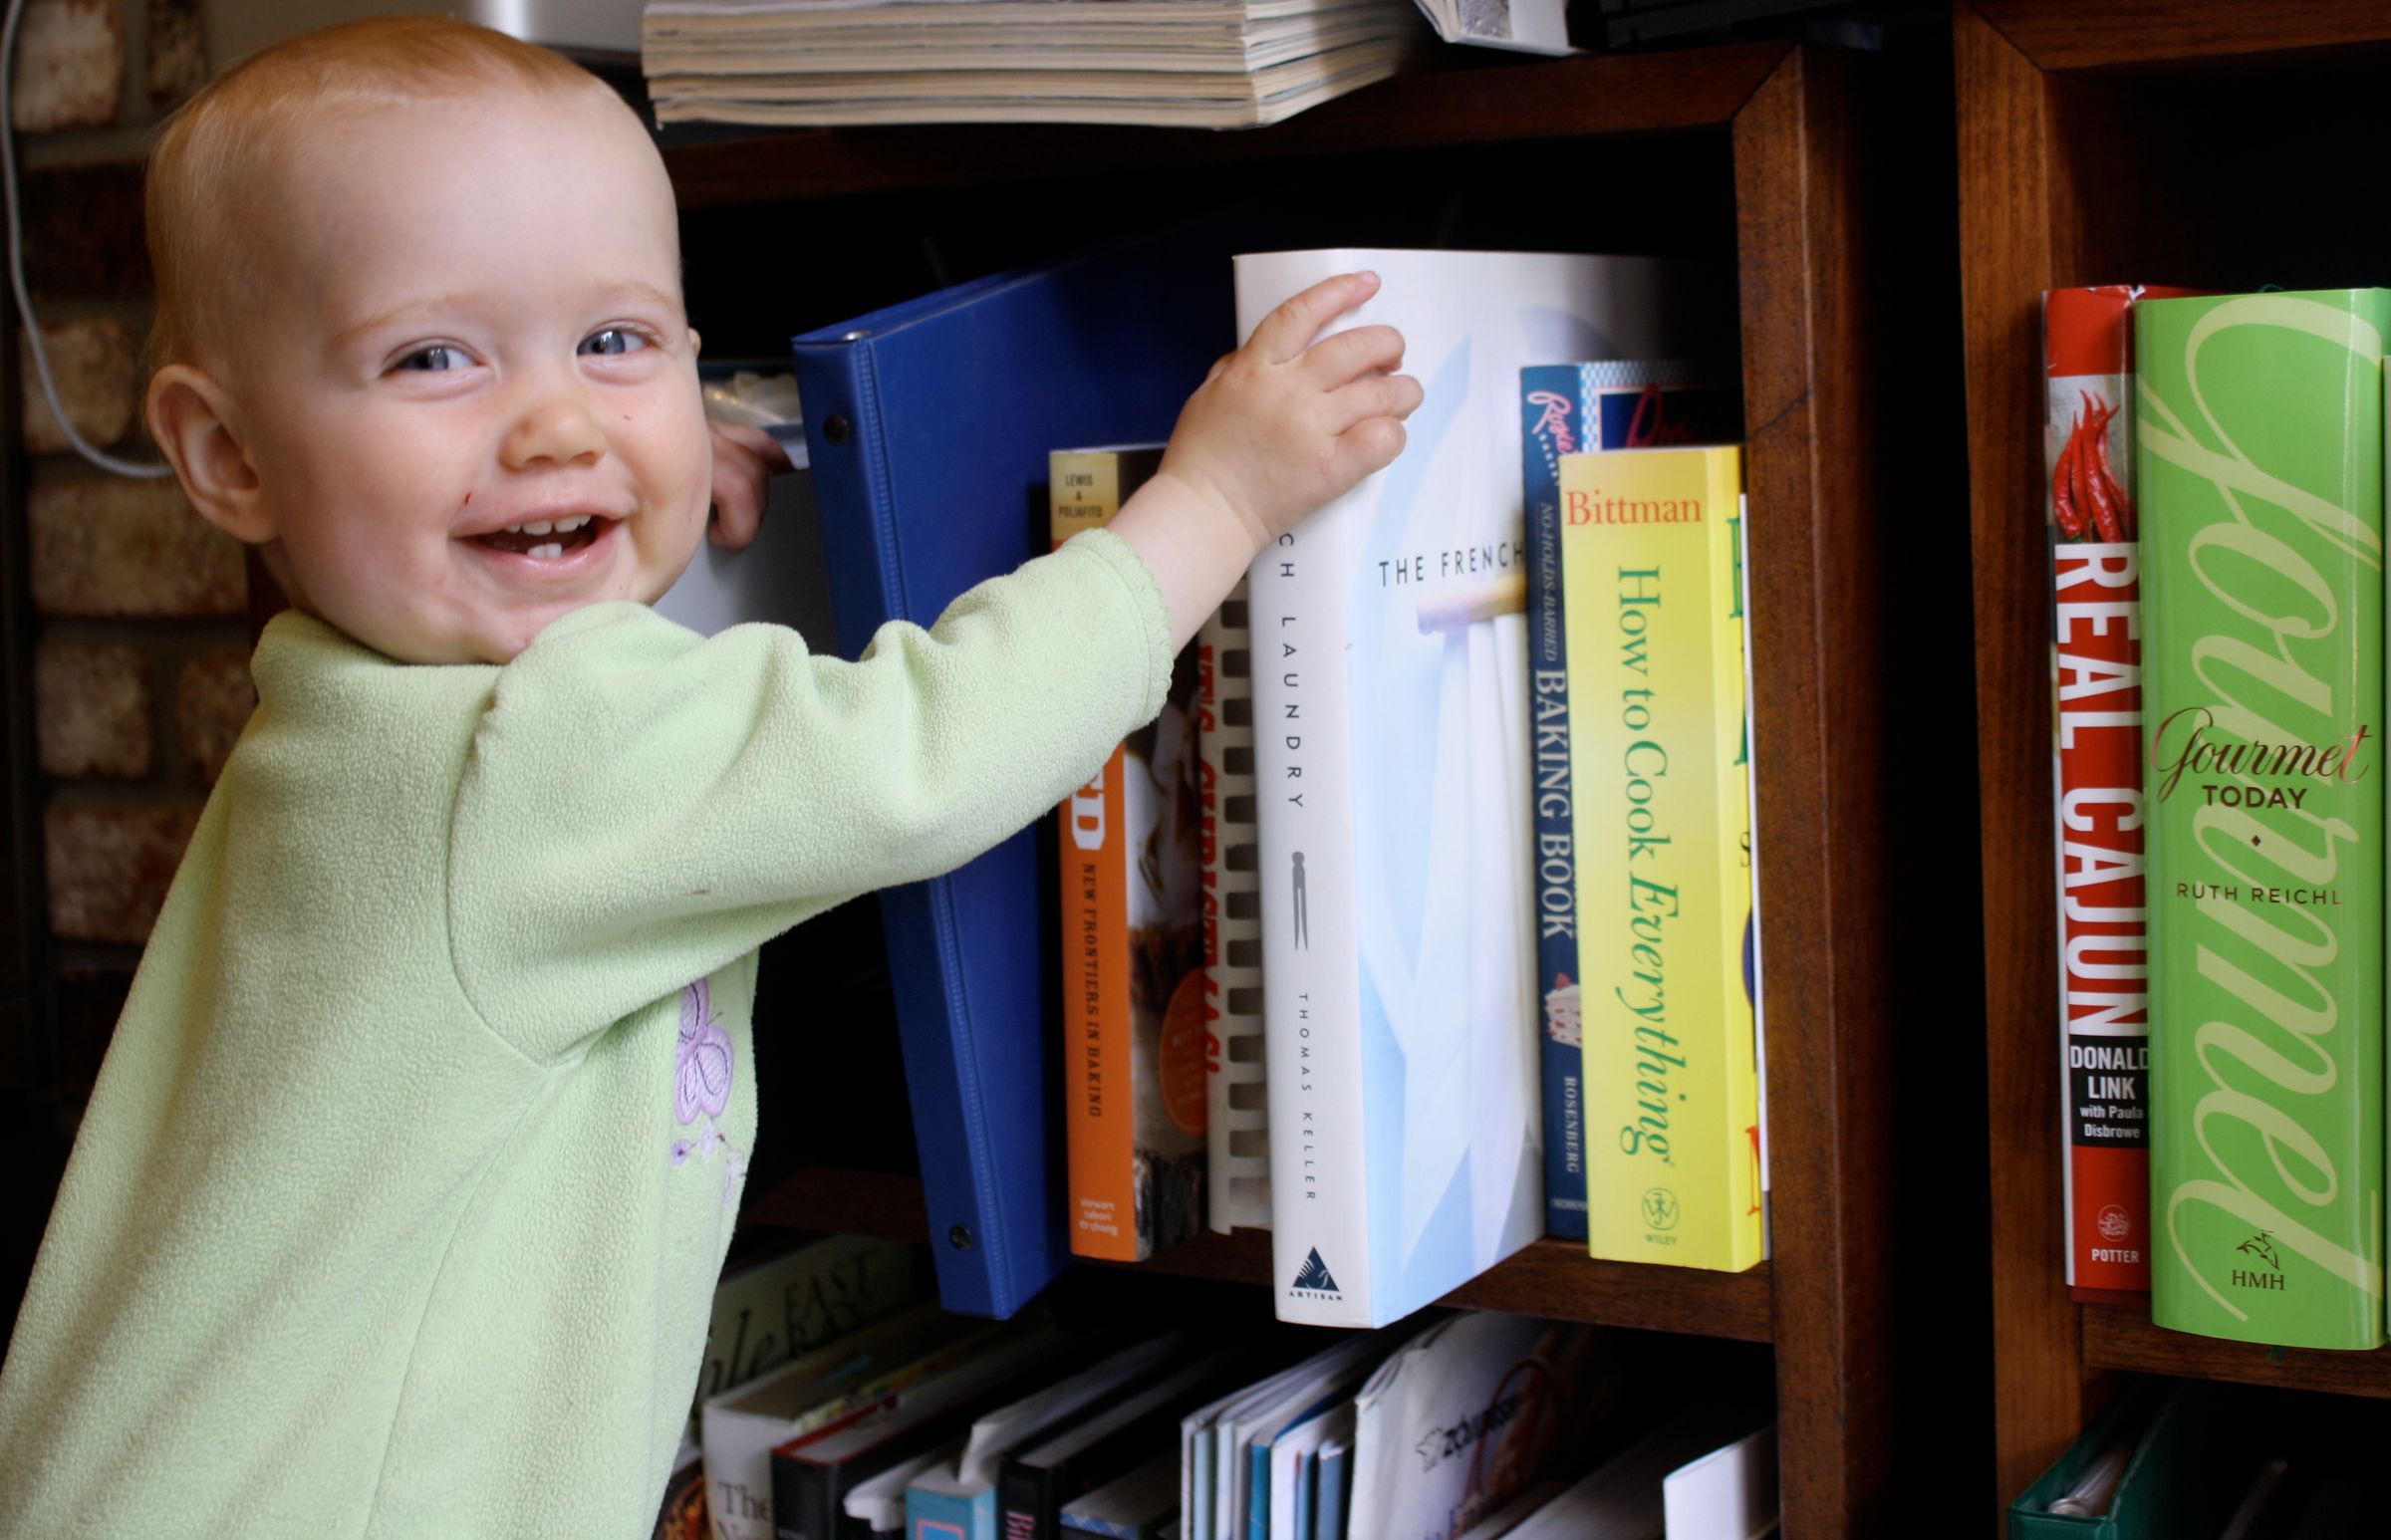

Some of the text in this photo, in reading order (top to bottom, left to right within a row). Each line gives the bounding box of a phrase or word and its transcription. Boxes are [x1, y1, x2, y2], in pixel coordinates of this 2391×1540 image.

[1064, 473, 1093, 487] LEWIS
[1566, 489, 1703, 526] Bittman
[1379, 542, 1524, 587] THE FRENCH
[1281, 616, 1303, 808] LAUNDRY
[2152, 706, 2374, 804] Gourmet
[1535, 669, 1574, 939] BAKING BOOK
[2054, 543, 2149, 1037] REAL CAJUN
[2202, 785, 2307, 810] TODAY
[1082, 863, 1097, 899] NEW
[1615, 566, 1688, 1165] How to Cook Everything
[2177, 883, 2344, 905] RUTH REICHL
[1083, 907, 1100, 1015] FRONTIERS
[1086, 1021, 1100, 1040] IN
[2070, 1045, 2149, 1070] DONALD
[1087, 1047, 1102, 1118] BAKING
[1298, 992, 1316, 1199] THOMAS KELLER
[2088, 1076, 2136, 1100] LINK
[1564, 1076, 1579, 1173] ROSENBERG
[2079, 1105, 2144, 1120] with Paula
[2084, 1124, 2141, 1139] Disbrowe
[2091, 1248, 2140, 1263] POTTER
[1289, 1291, 1343, 1301] ARTISAN
[2232, 1269, 2285, 1291] HMH
